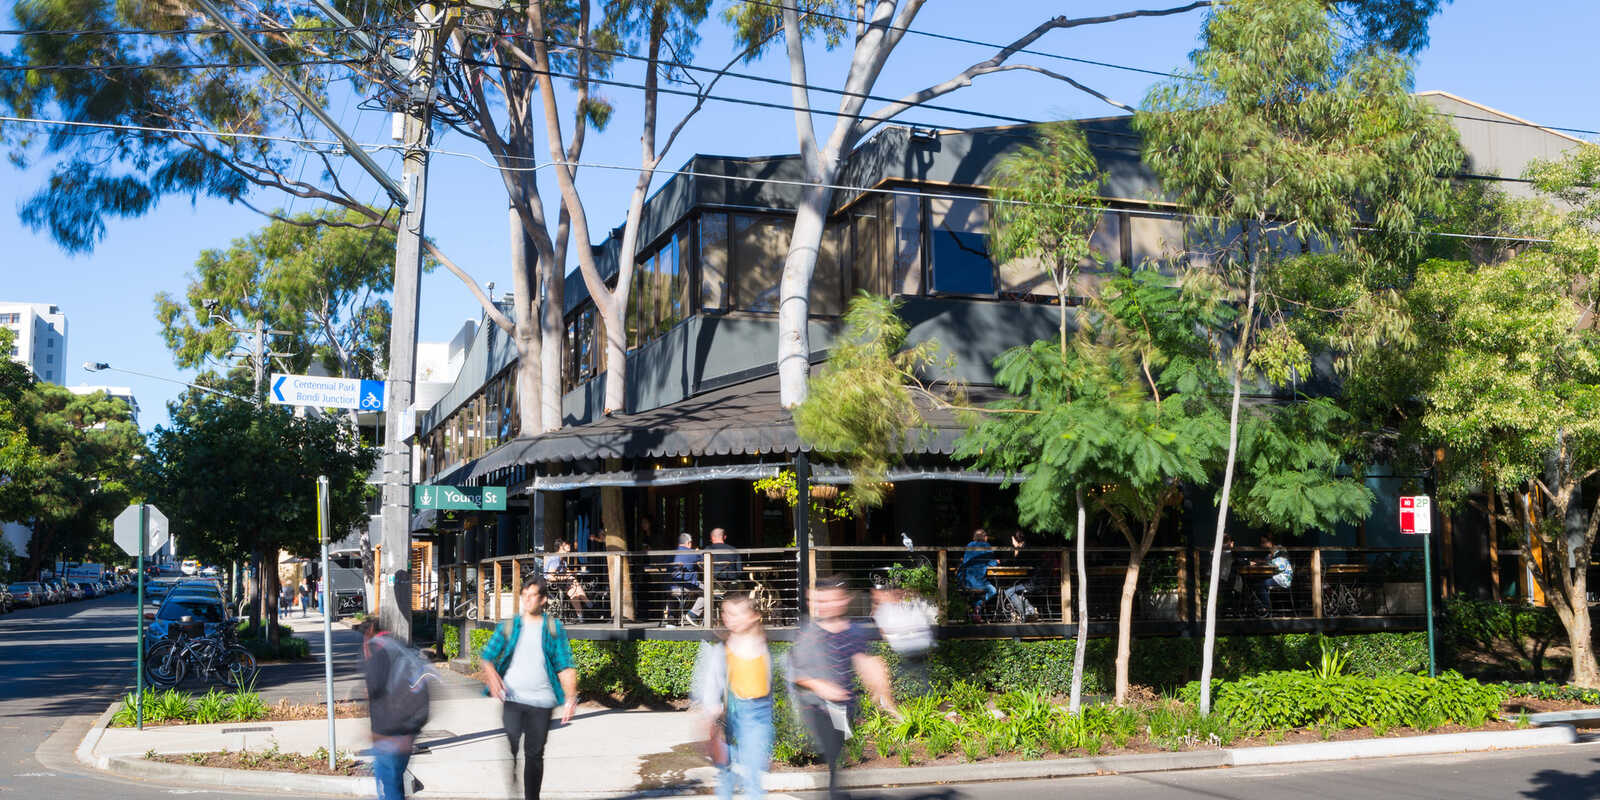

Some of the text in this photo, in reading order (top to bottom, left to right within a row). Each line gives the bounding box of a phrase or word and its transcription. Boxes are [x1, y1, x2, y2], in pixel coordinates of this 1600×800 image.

[294, 379, 356, 392] Centennial Park
[296, 391, 356, 405] Bondi Junction
[444, 490, 497, 506] Young St
[1416, 498, 1428, 508] 2P
